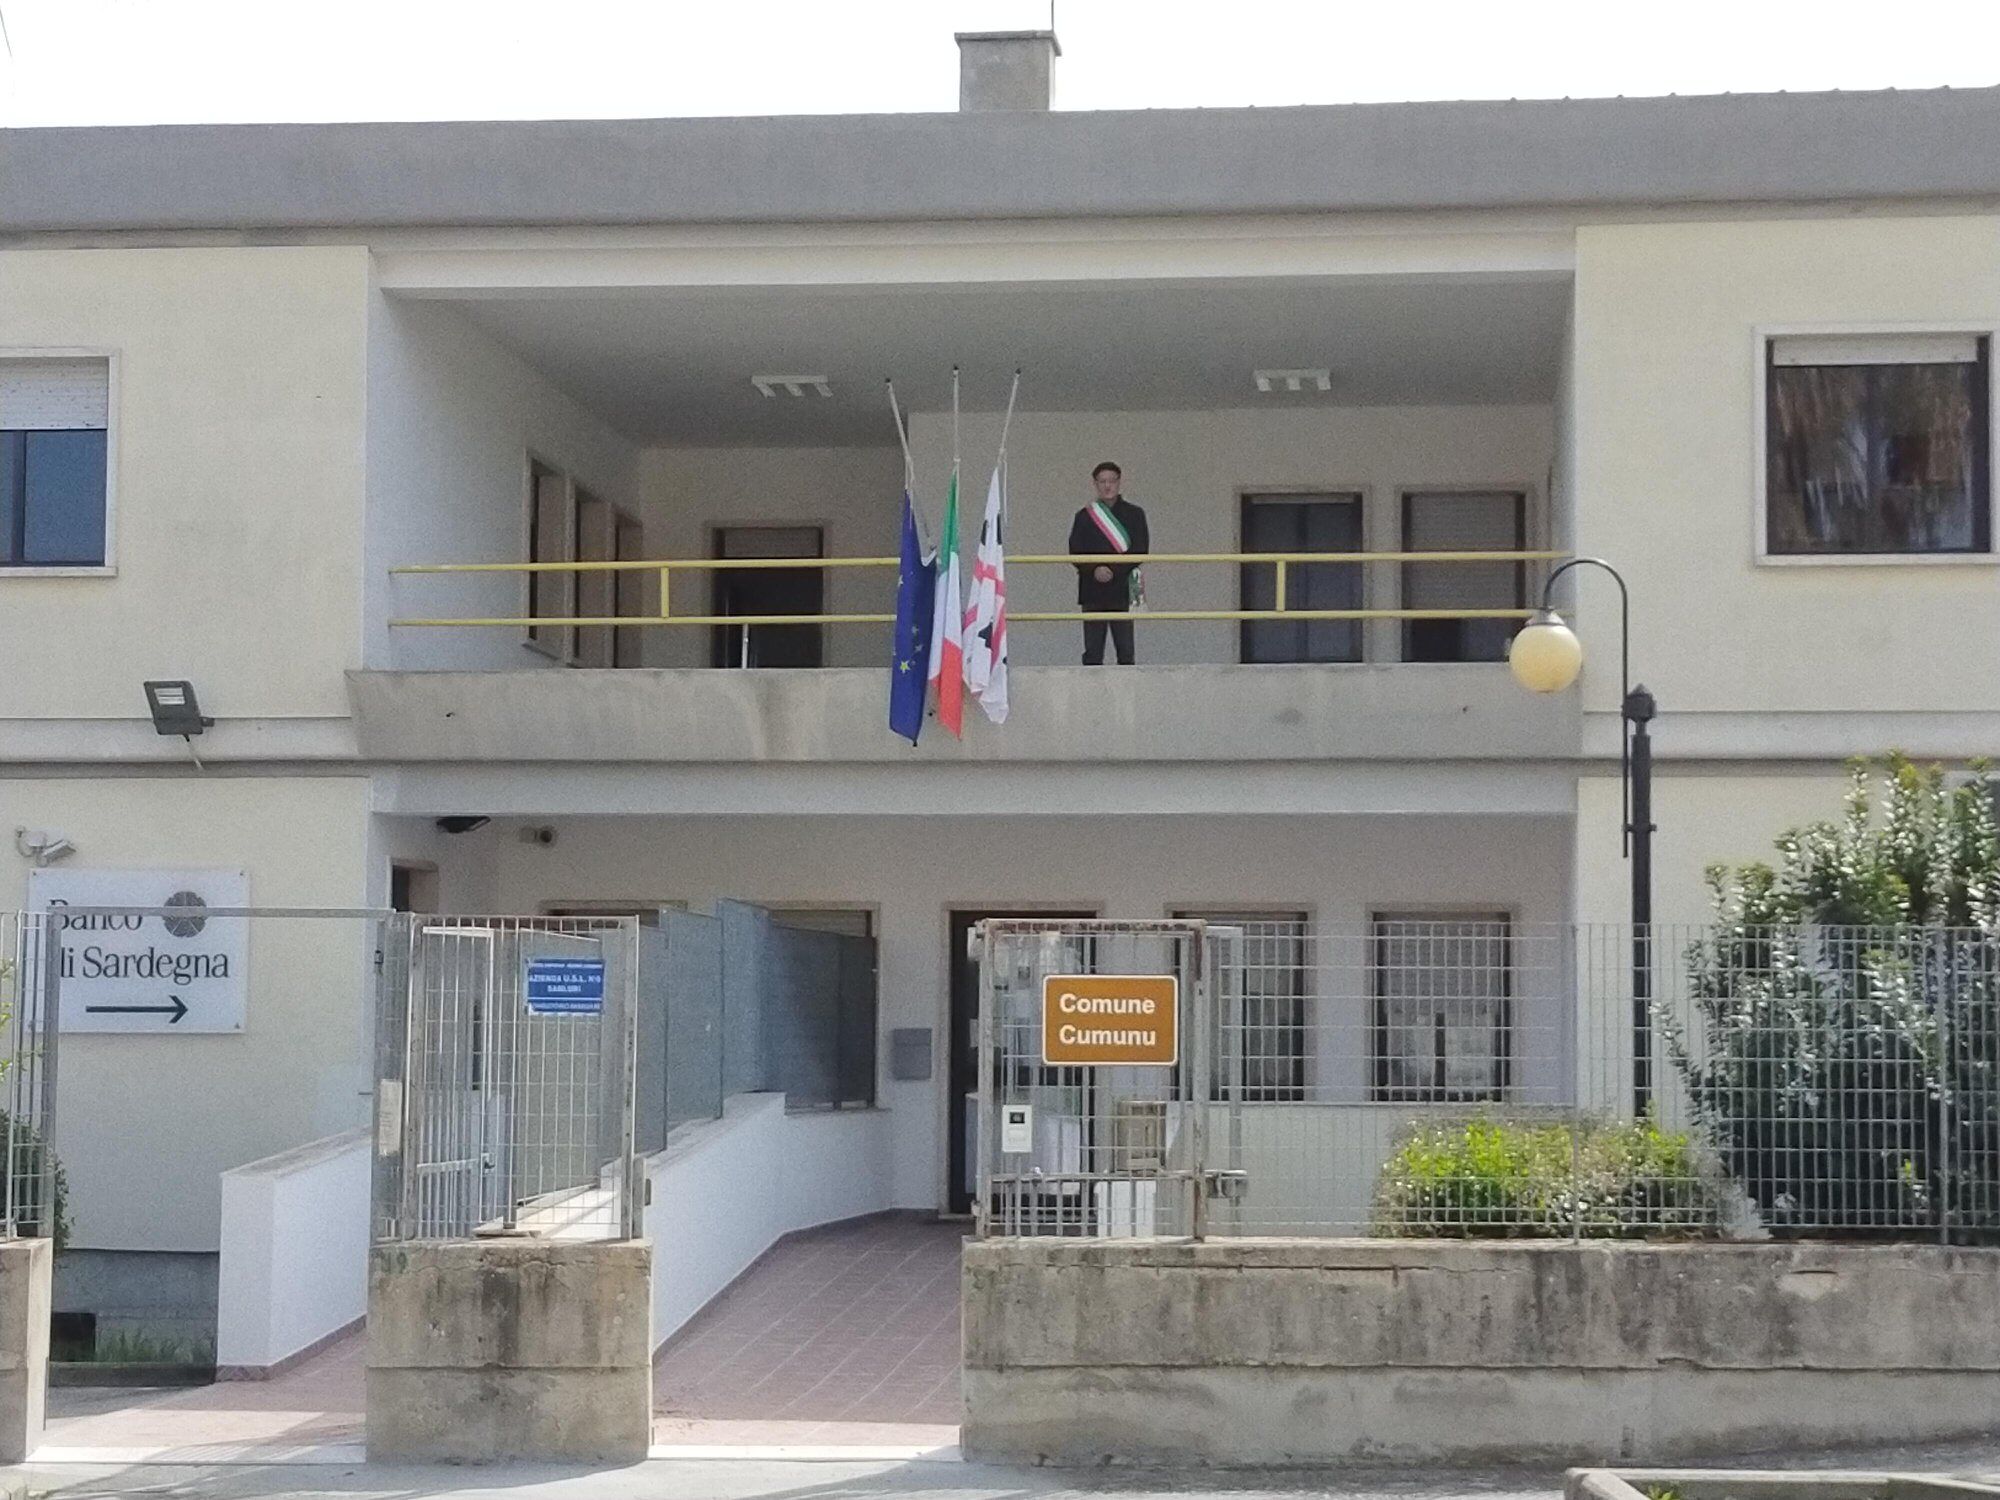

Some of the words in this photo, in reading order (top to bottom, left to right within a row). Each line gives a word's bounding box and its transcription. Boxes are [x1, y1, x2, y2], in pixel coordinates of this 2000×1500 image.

[83, 946, 229, 986] Sardegna
[1059, 993, 1156, 1014] Comune
[1059, 1024, 1156, 1046] Cumunu
